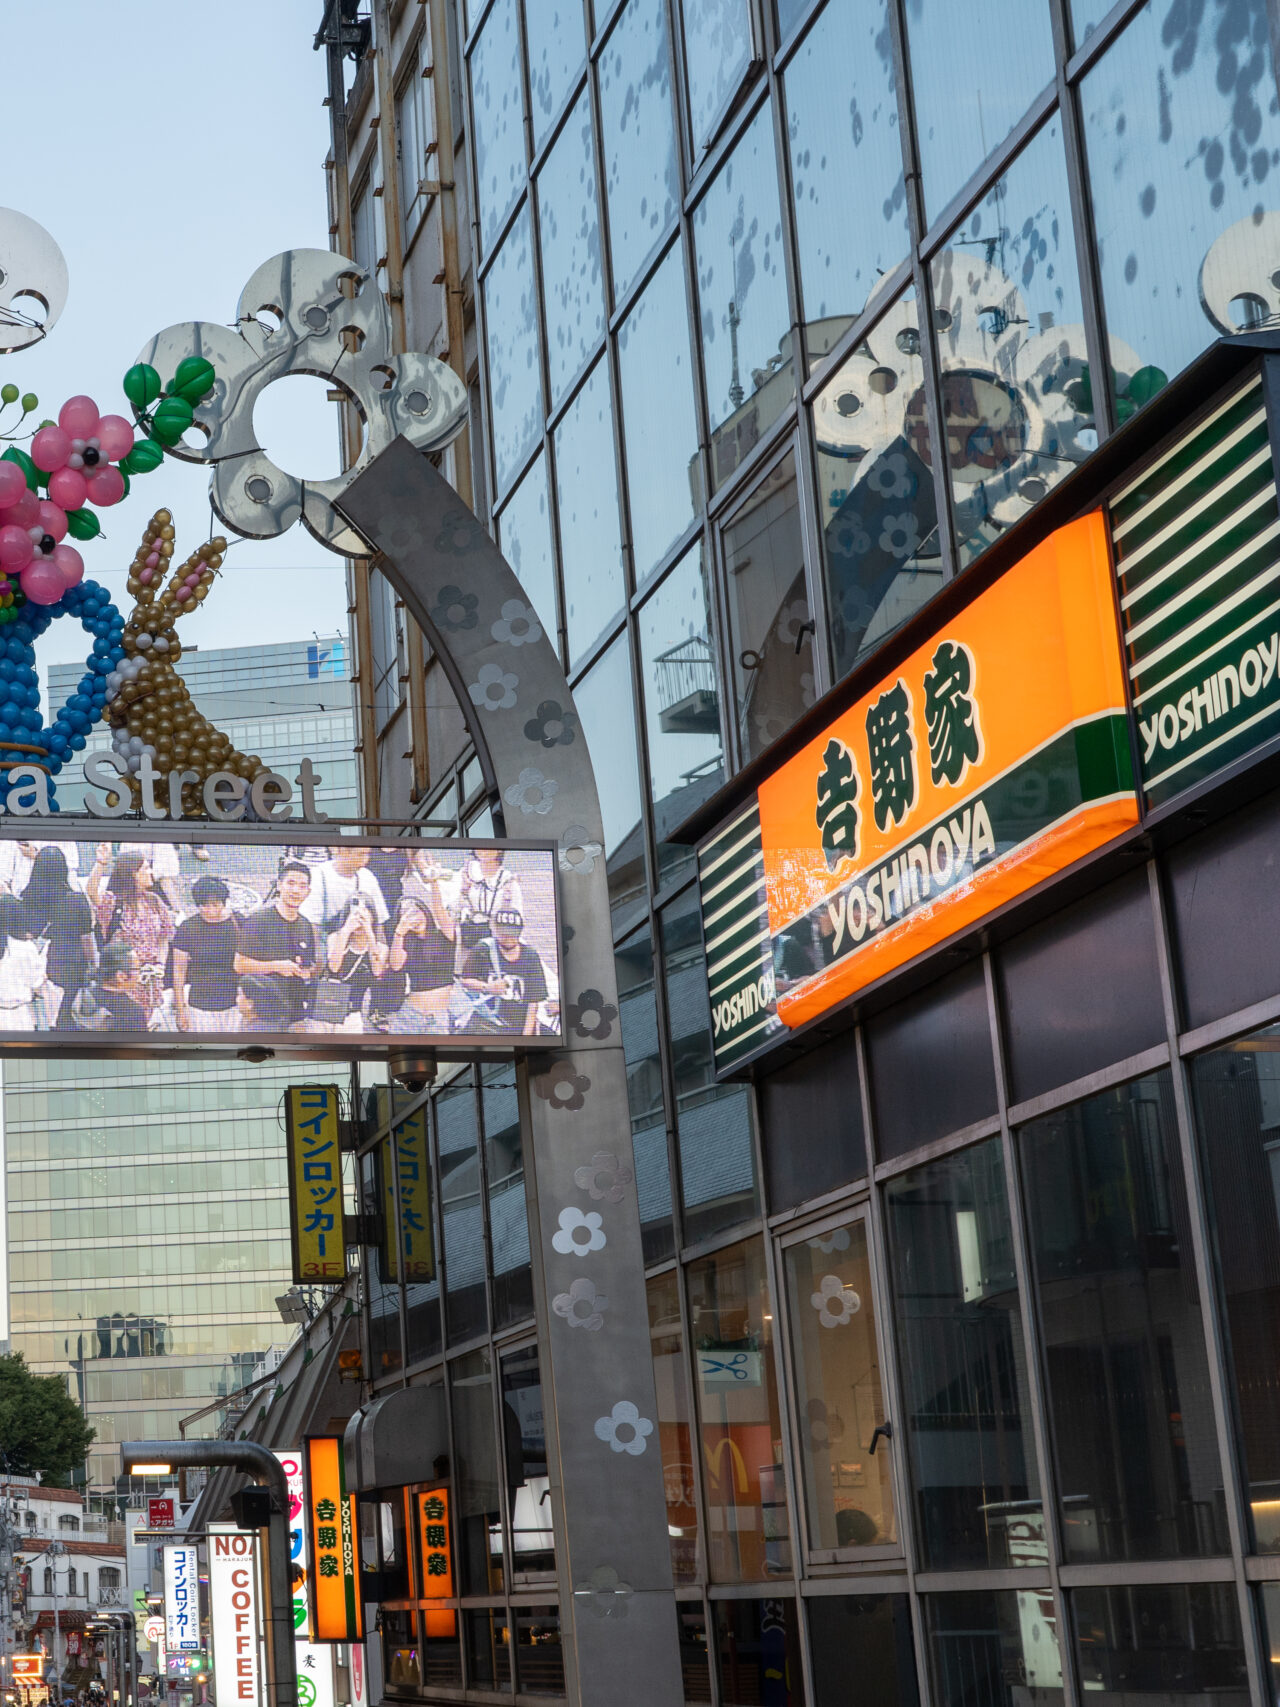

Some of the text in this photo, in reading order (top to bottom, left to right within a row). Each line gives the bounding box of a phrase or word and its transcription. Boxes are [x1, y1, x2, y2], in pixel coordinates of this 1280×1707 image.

[1139, 632, 1280, 764] YOSHINOY
[83, 751, 328, 823] Street
[816, 640, 983, 874] 吉野家
[828, 800, 995, 955] YOSHINOYA
[298, 1090, 337, 1256] コインロッカー
[303, 1262, 341, 1277] 3F
[316, 1499, 338, 1577] 吉野家
[341, 1501, 353, 1575] YOSHINOYA
[174, 1551, 188, 1637] コインロッカー
[189, 1582, 197, 1603] Coin
[231, 1569, 255, 1699] COFFEE
